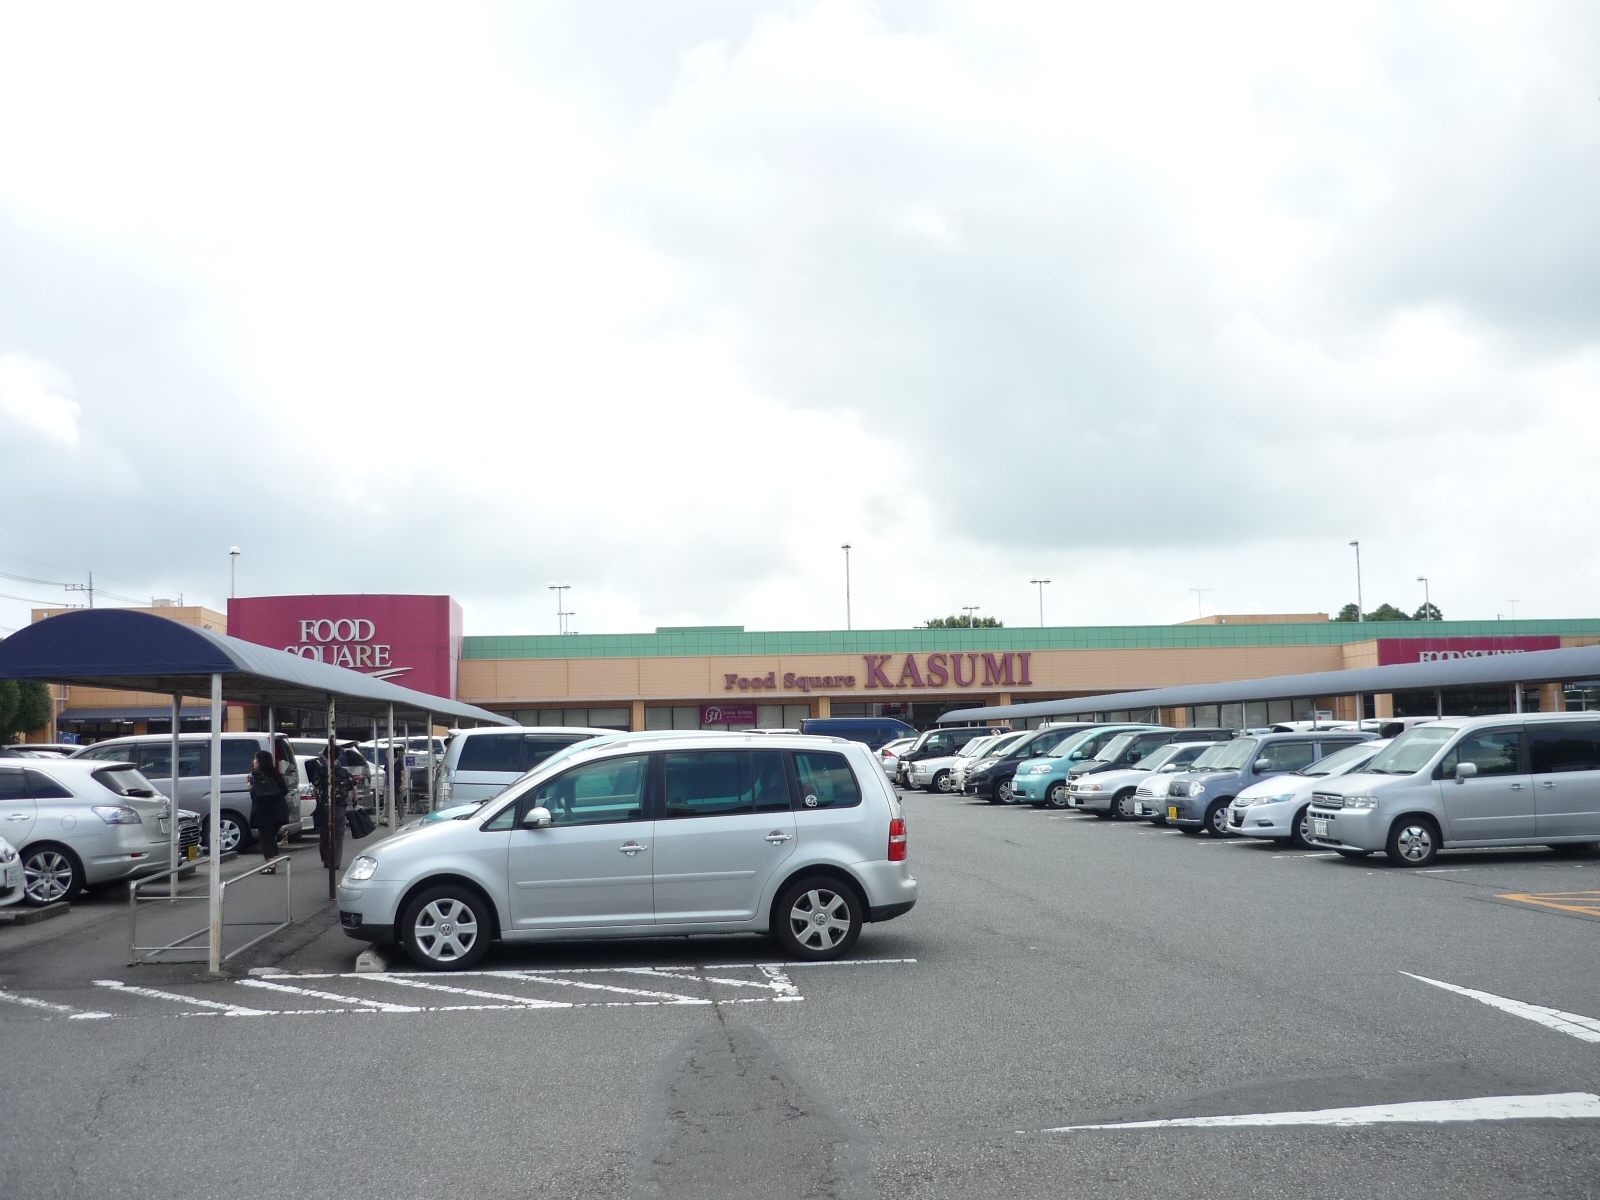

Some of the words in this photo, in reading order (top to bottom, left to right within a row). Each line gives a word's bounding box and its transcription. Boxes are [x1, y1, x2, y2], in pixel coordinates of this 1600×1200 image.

[299, 618, 376, 643] FOOD
[724, 671, 777, 690] Food
[783, 672, 856, 692] Square
[864, 652, 1032, 688] KASUMI
